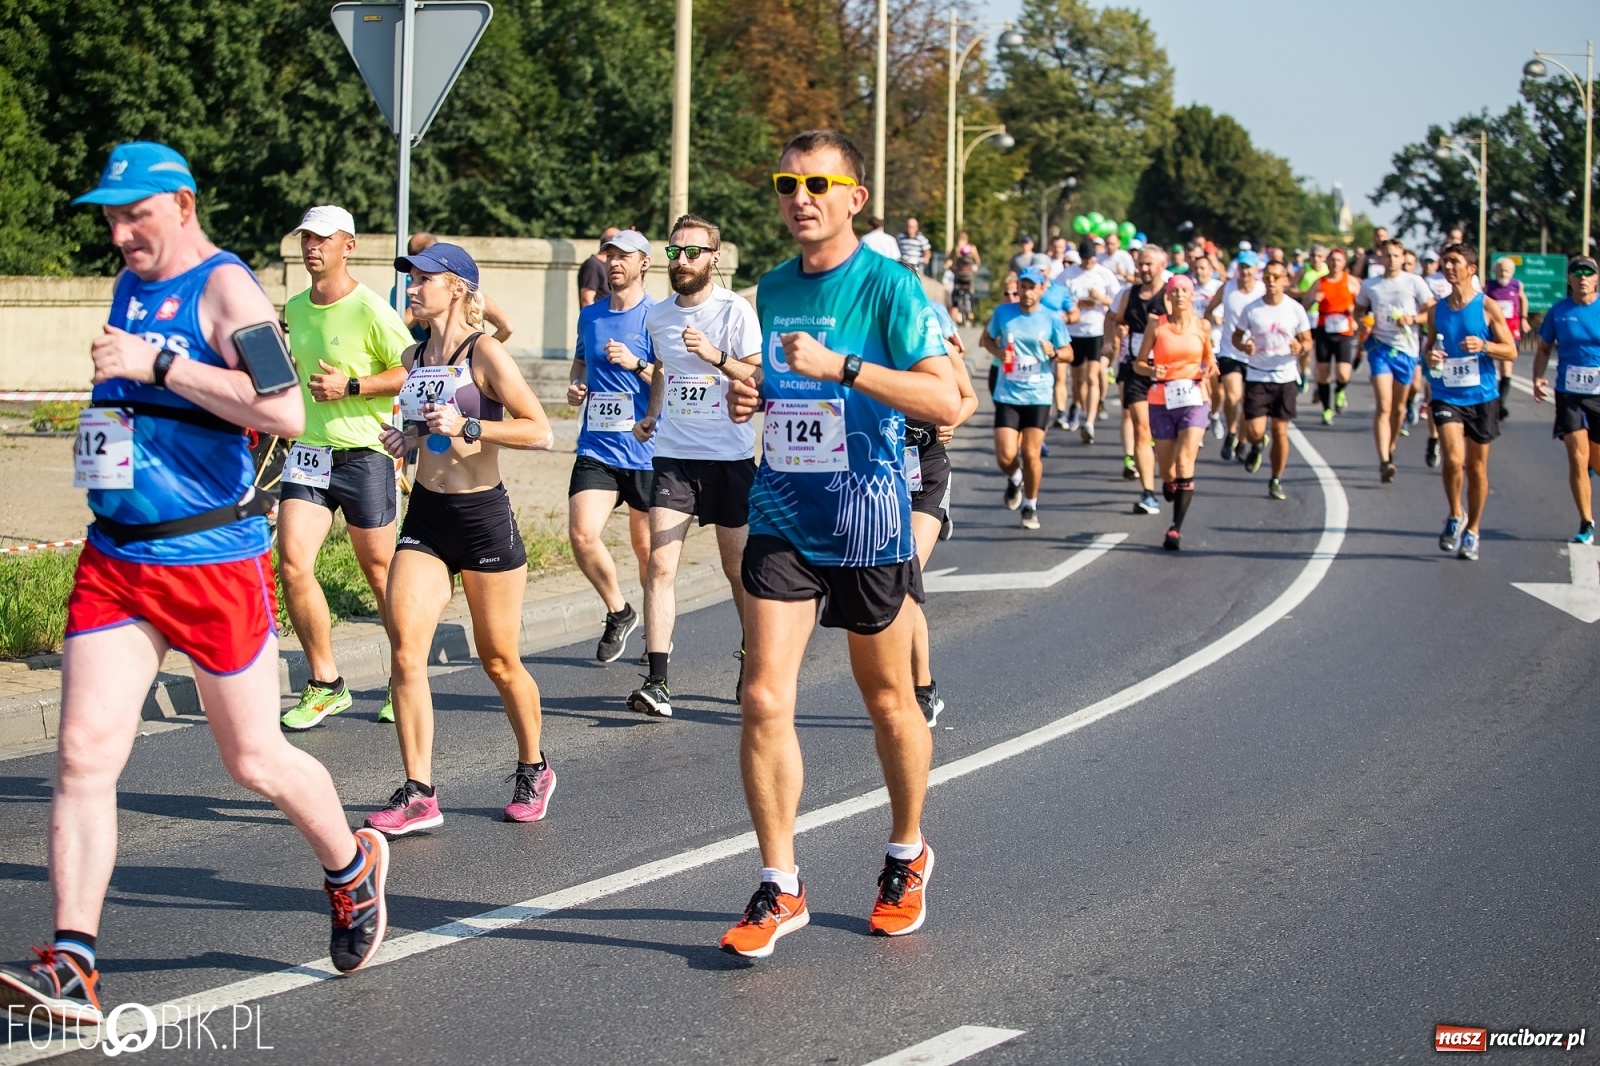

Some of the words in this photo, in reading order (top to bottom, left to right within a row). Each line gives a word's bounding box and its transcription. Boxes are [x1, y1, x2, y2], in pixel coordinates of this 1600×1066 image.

[780, 379, 822, 391] RACIBÓRZ
[680, 386, 707, 401] 327
[599, 402, 622, 416] 256
[785, 420, 823, 443] 124
[296, 450, 319, 469] 156
